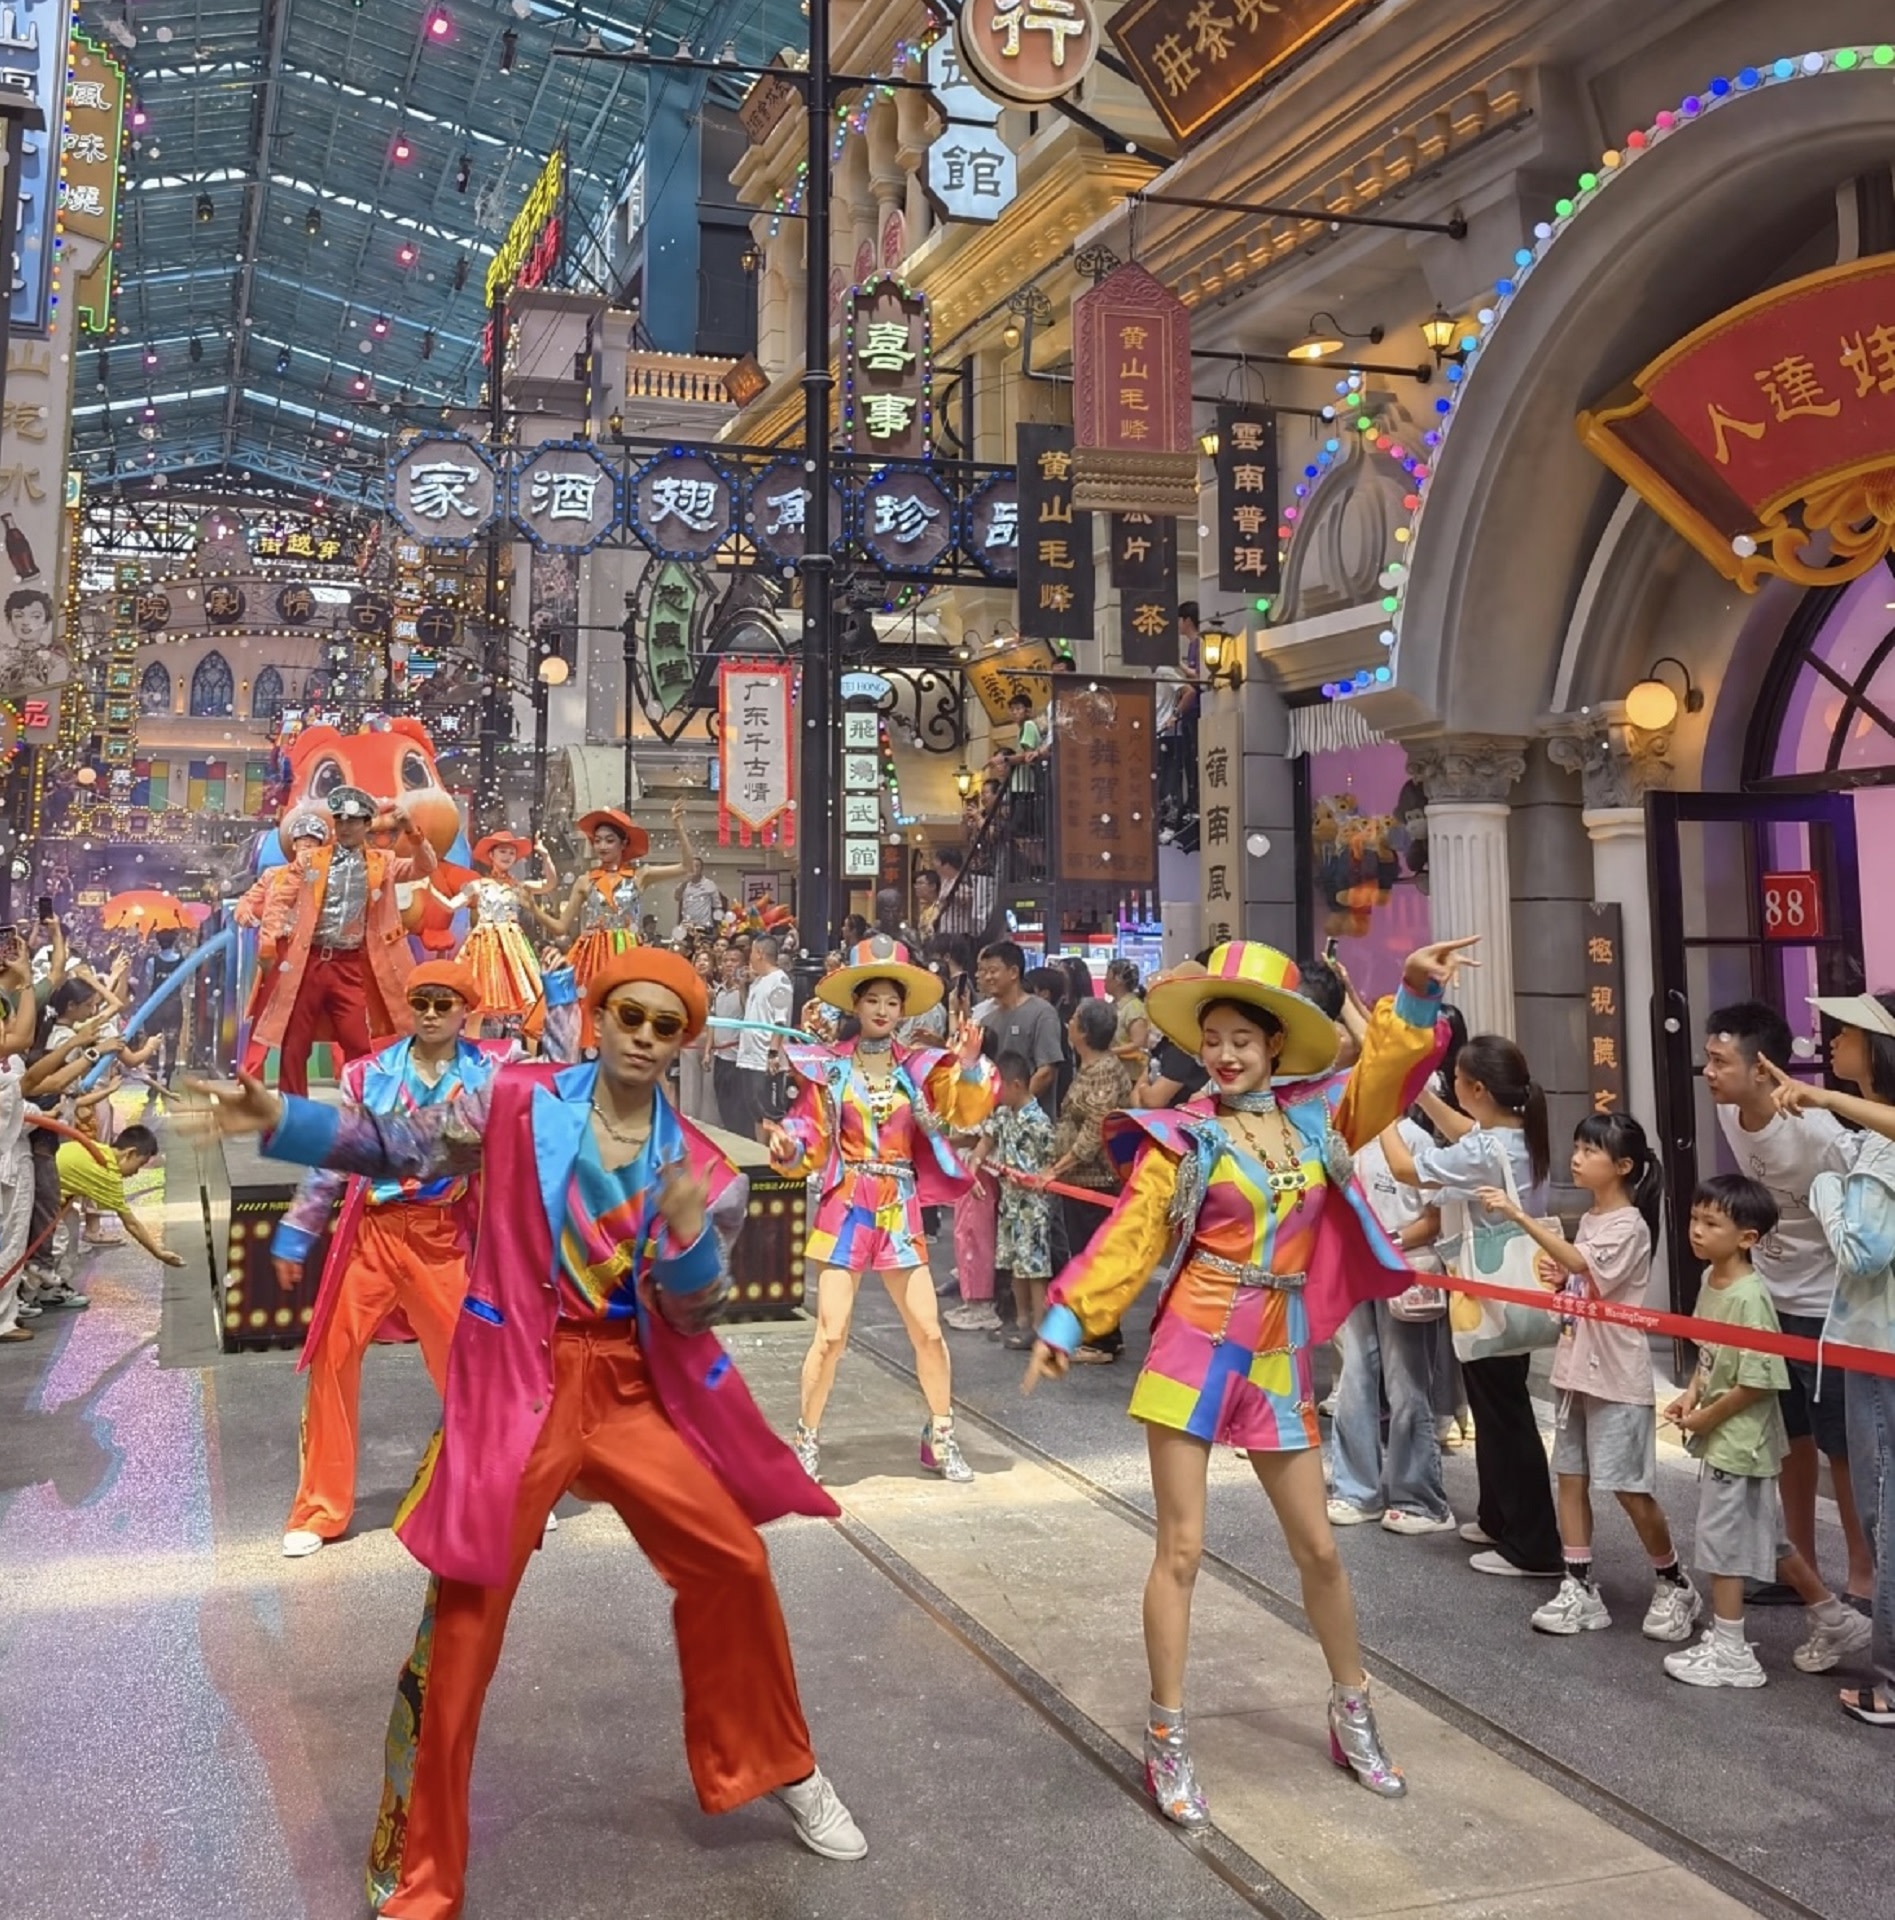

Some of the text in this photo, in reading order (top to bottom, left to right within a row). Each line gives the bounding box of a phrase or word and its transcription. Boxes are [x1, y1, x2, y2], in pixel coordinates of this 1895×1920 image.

[858, 321, 917, 439] 喜事
[1119, 326, 1150, 442] 黄山毛峰
[1037, 450, 1075, 613] 黄山毛峰
[1230, 422, 1268, 578] 雲南普洱
[743, 681, 771, 803] 广东千古情
[1765, 889, 1805, 926] 88
